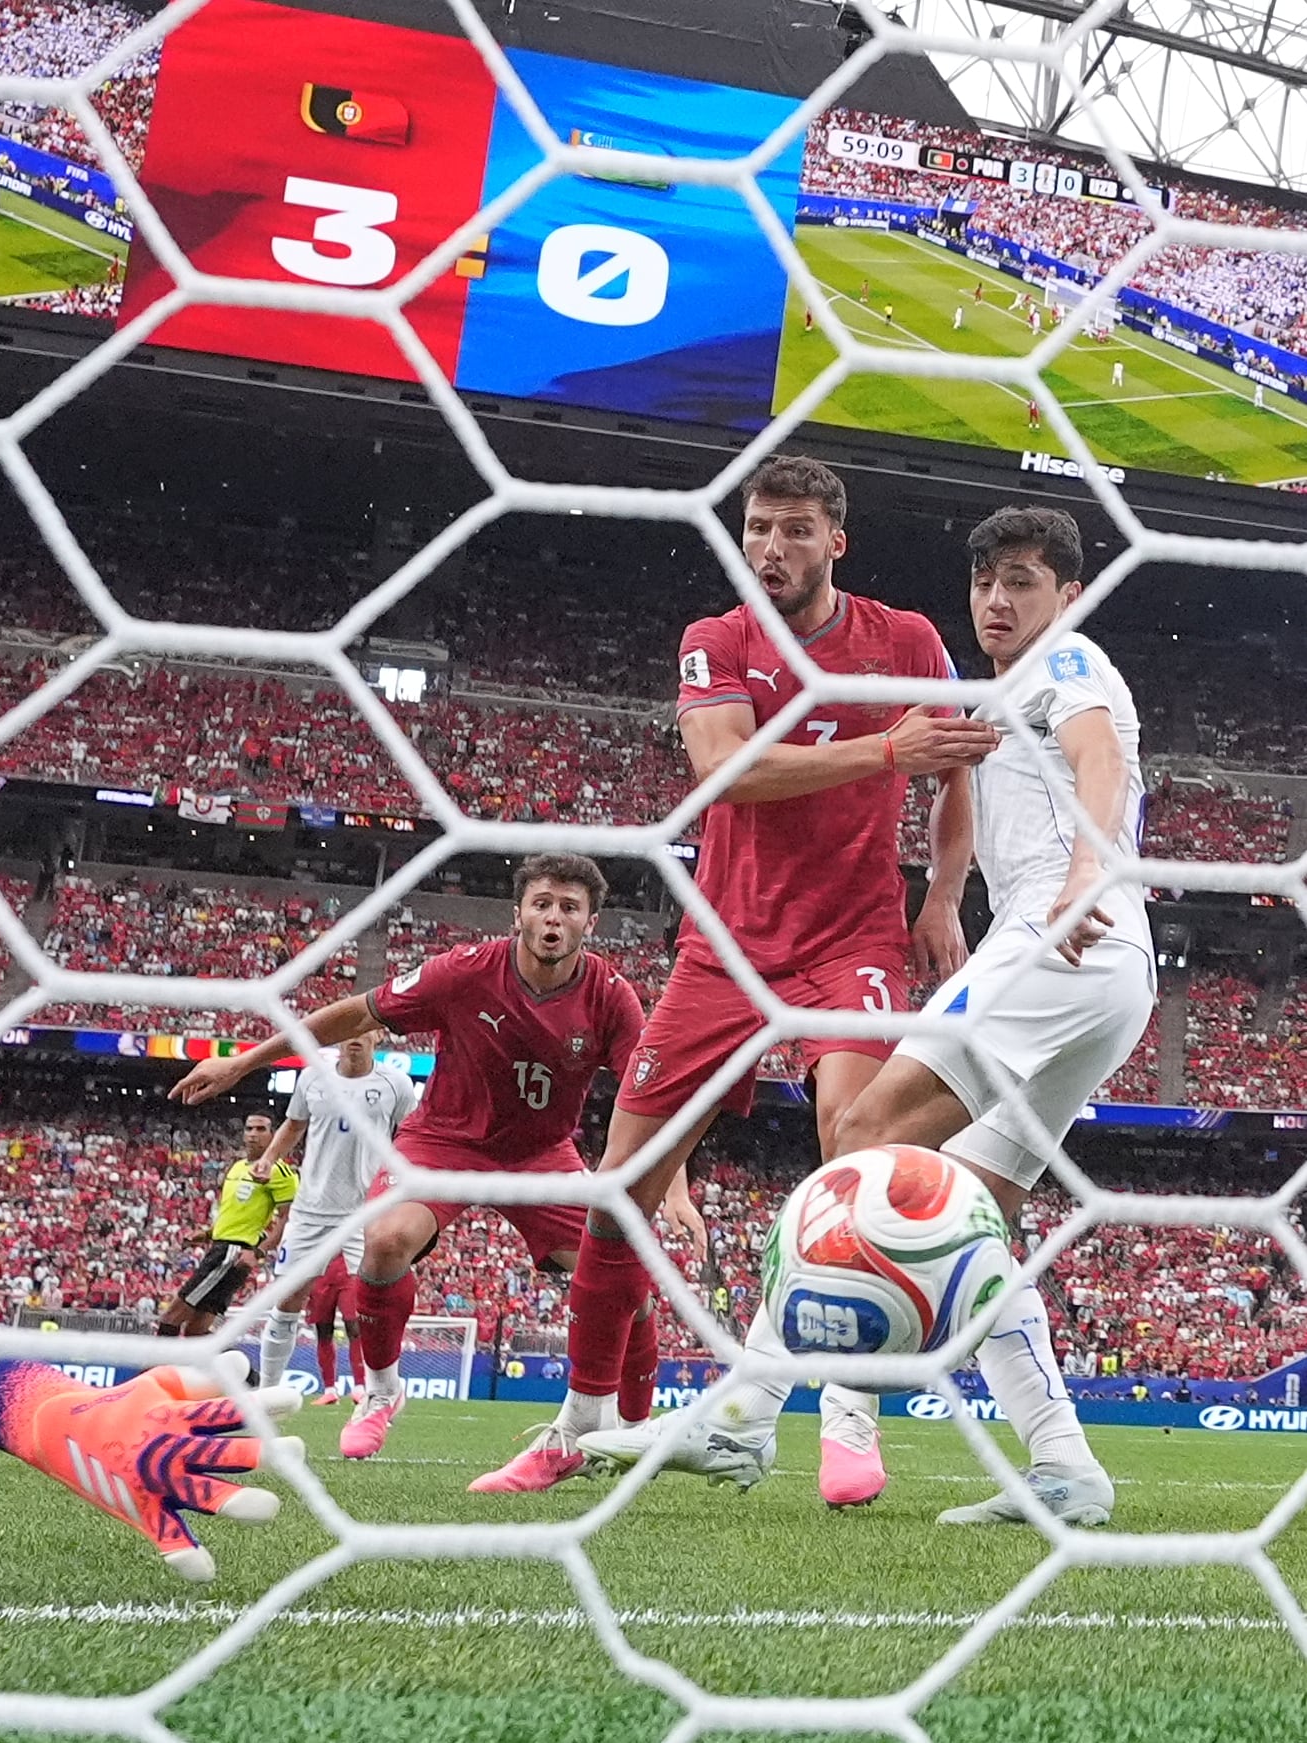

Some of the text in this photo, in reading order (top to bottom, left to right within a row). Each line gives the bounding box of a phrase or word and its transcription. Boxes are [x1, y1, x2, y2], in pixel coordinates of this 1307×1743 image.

[842, 135, 904, 161] 59:09
[66, 164, 89, 182] FIFA
[972, 157, 1004, 178] POR
[1016, 167, 1028, 183] 3
[1064, 176, 1075, 191] 0
[271, 176, 398, 286] 3
[537, 223, 669, 326] 0
[663, 845, 695, 859] 026
[856, 966, 893, 1017] 3
[513, 1061, 553, 1110] 15
